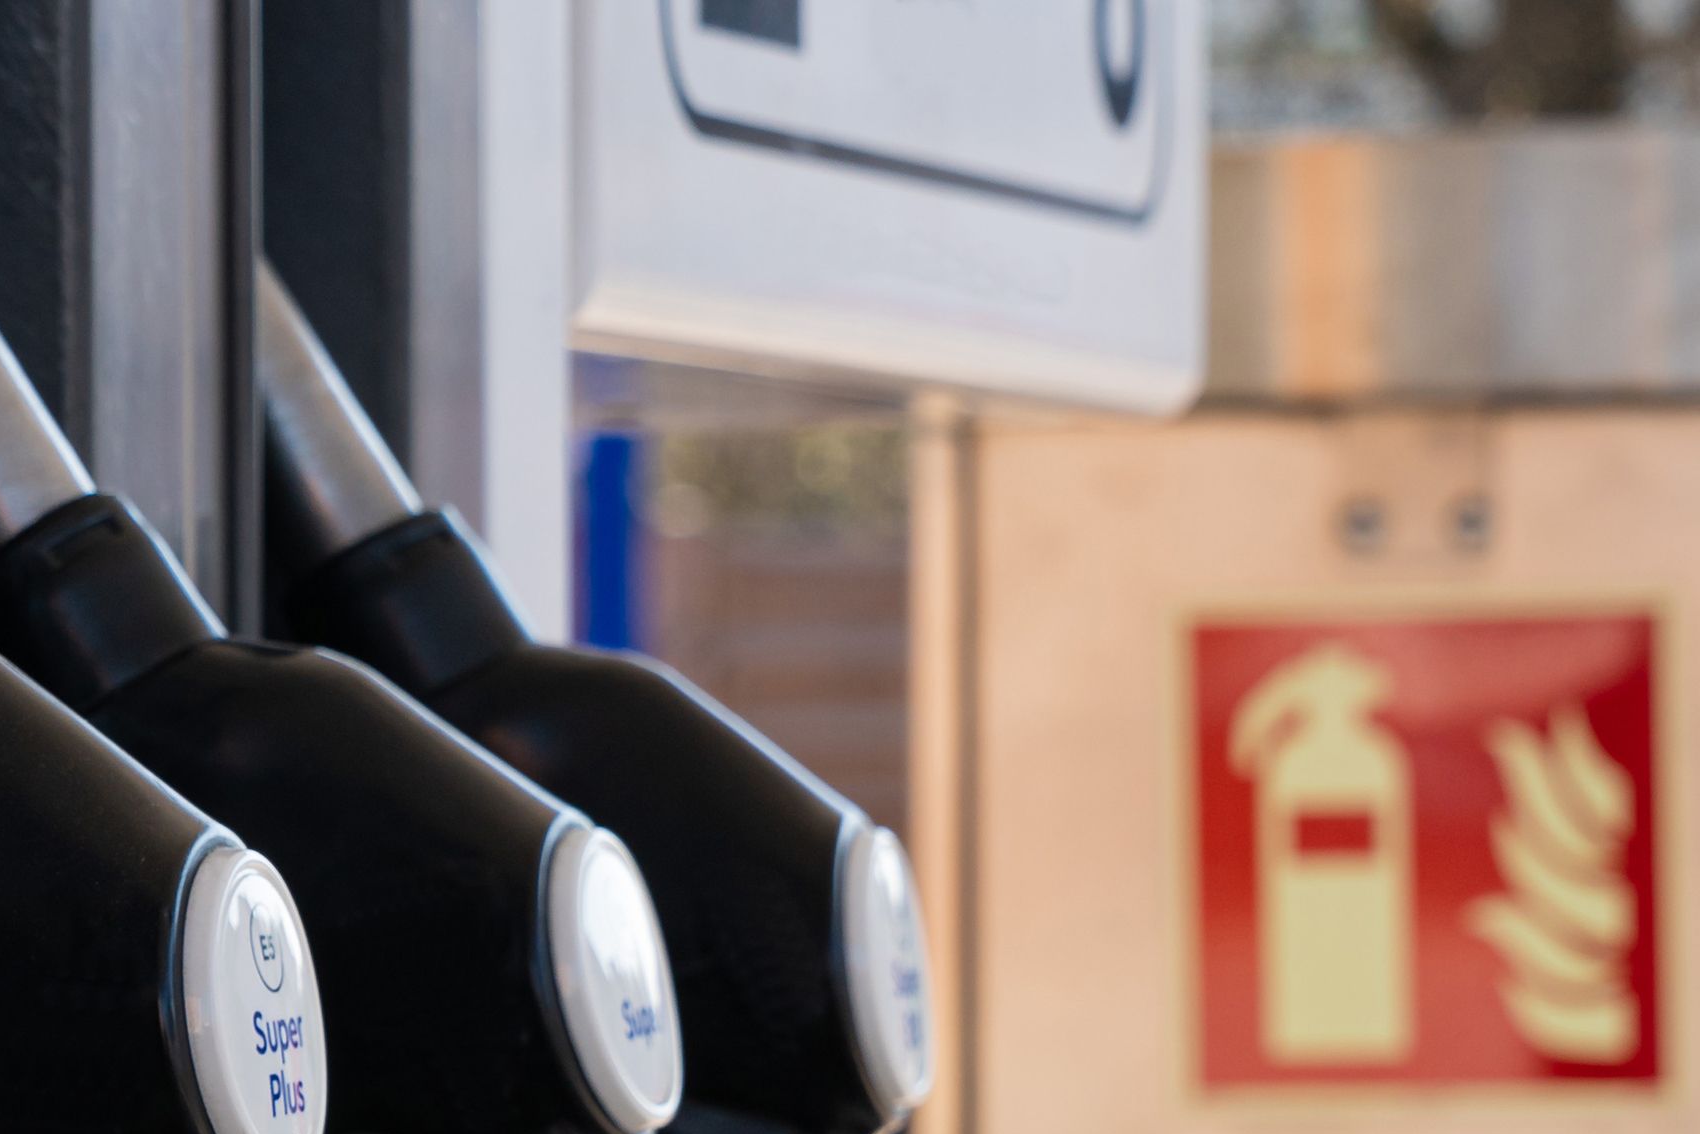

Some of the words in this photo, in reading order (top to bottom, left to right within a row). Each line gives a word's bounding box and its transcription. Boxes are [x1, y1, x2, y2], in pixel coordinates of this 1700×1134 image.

[258, 934, 276, 961] E5
[253, 1010, 303, 1063] Super
[269, 1070, 306, 1118] Plus
